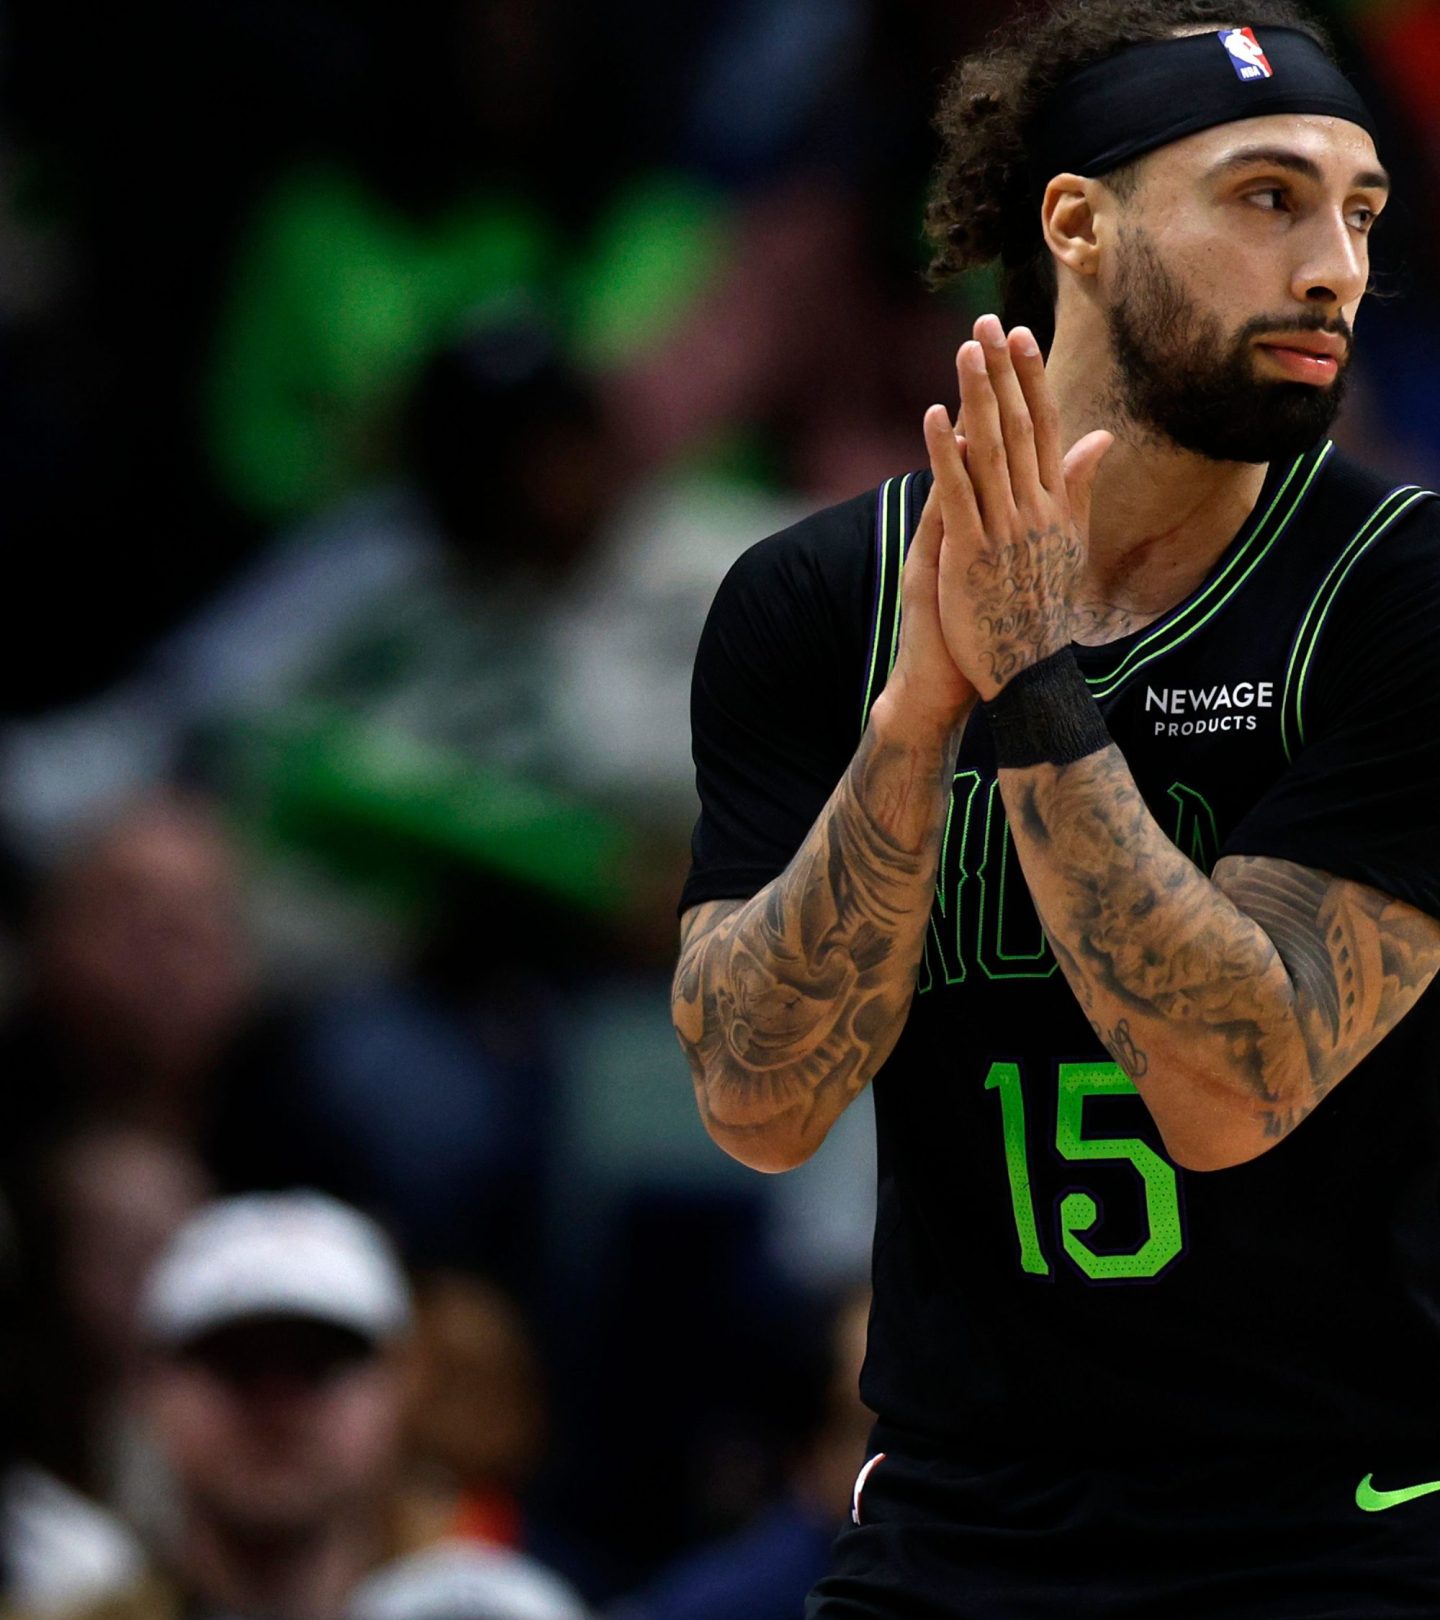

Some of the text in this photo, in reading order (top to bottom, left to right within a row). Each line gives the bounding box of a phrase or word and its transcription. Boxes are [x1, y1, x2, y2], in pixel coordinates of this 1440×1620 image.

[1145, 682, 1274, 714] NEWAGE
[1154, 716, 1257, 736] PRODUCTS
[984, 1062, 1182, 1279] 15
